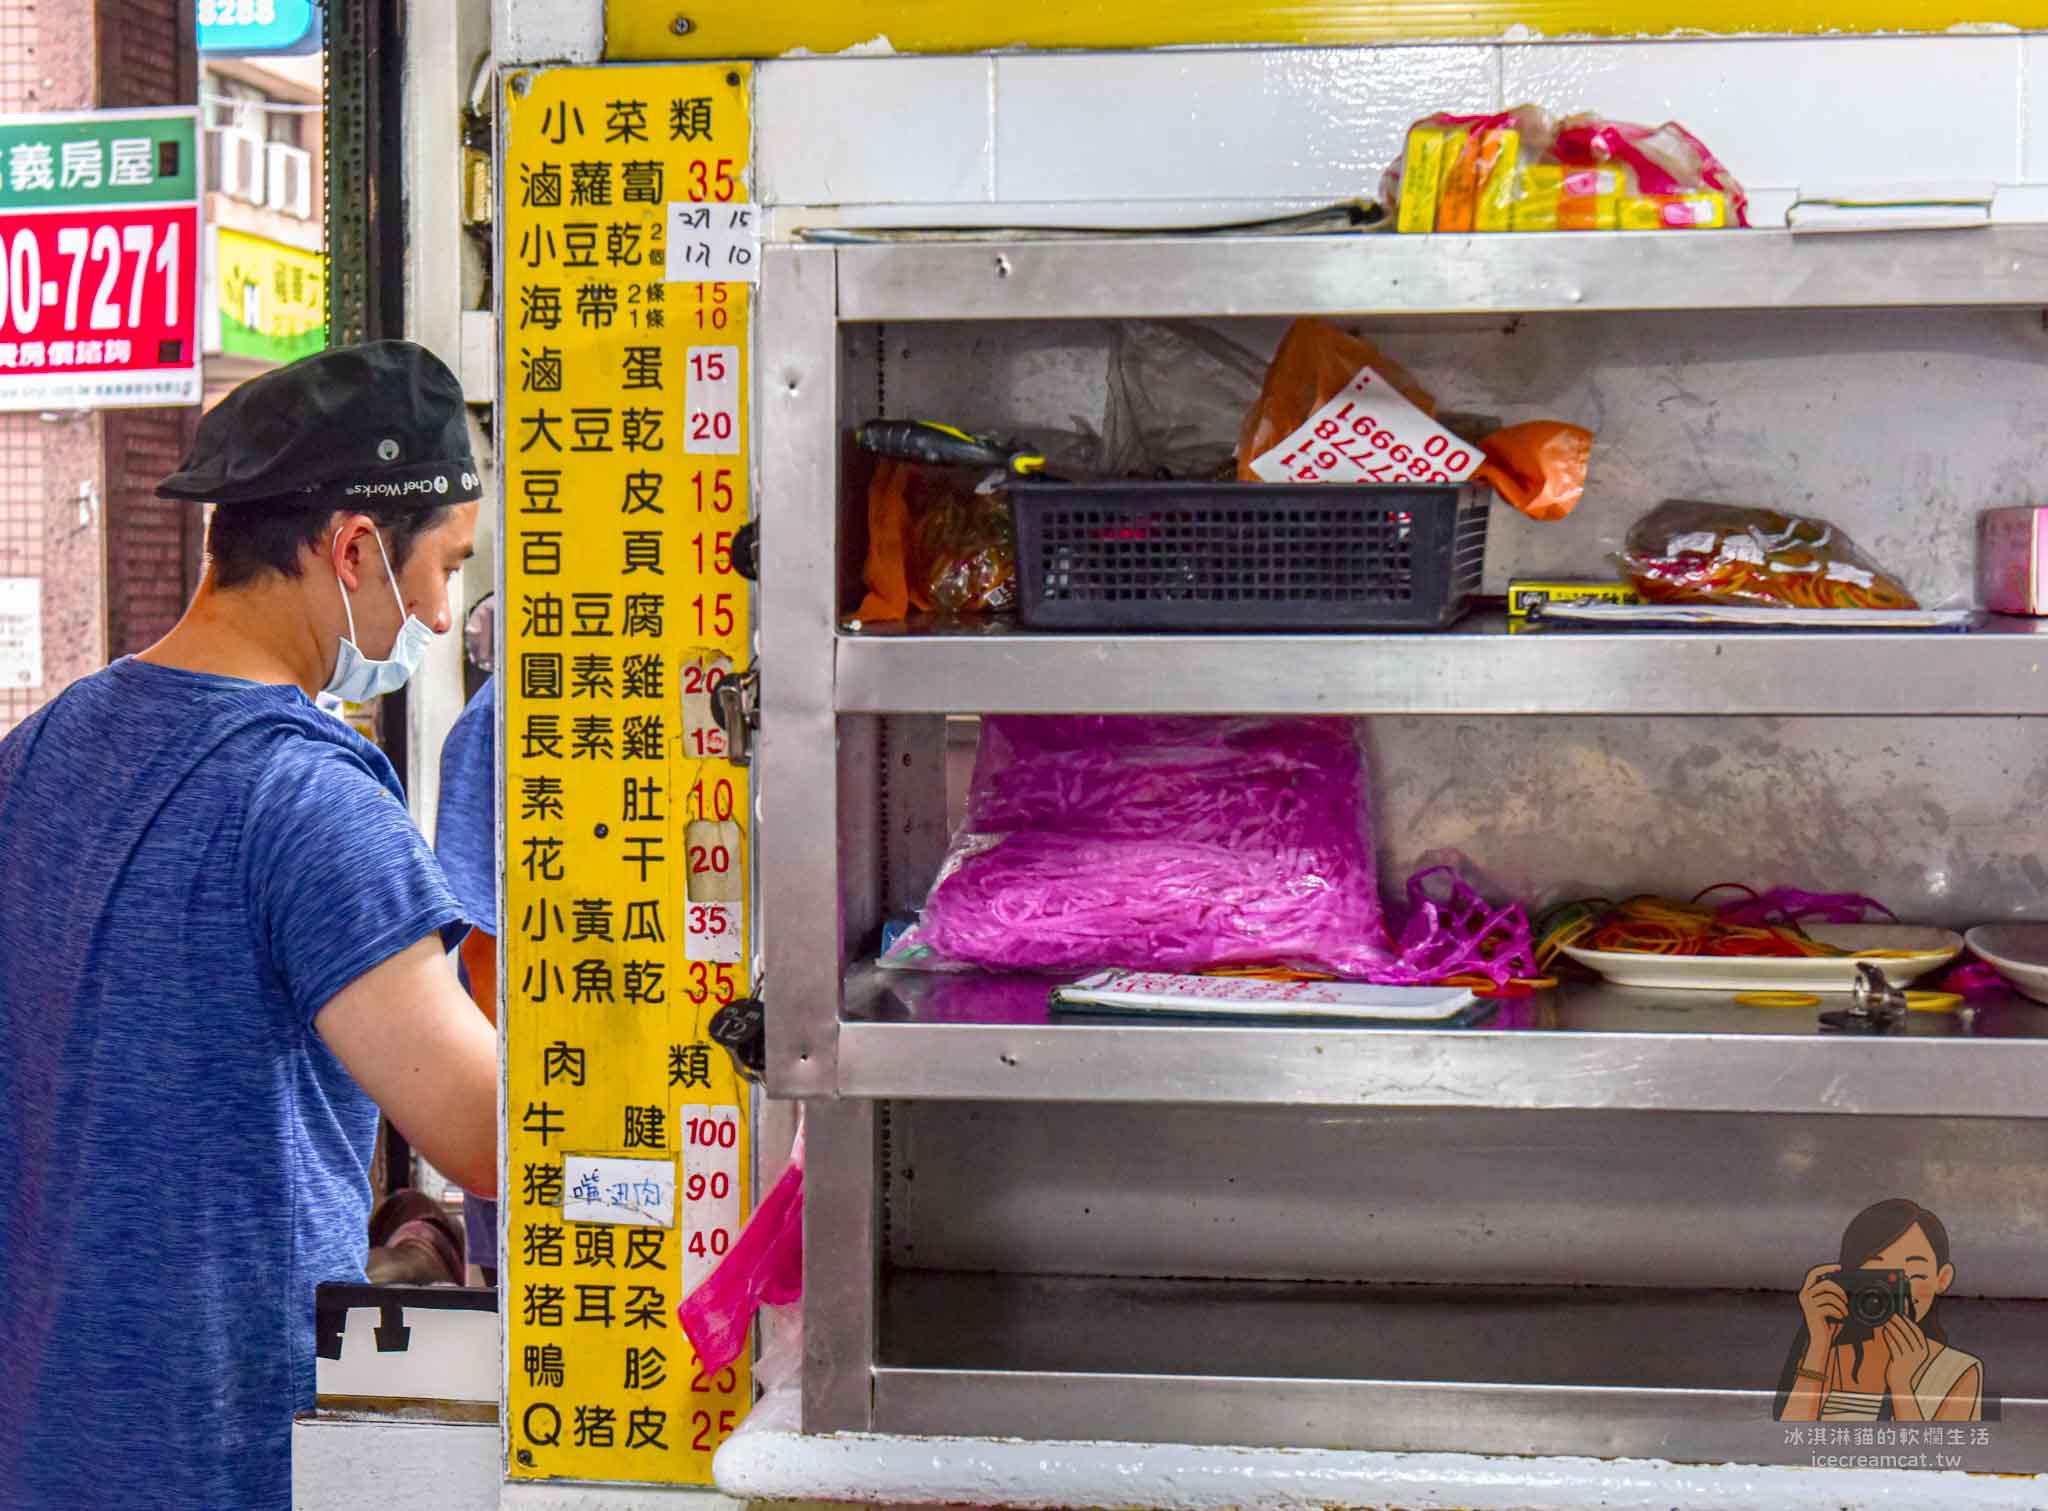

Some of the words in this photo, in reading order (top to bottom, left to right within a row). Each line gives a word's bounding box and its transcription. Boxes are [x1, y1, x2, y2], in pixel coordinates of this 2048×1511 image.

[541, 97, 713, 144] 小菜類
[0, 138, 153, 190] 義房屋
[520, 160, 664, 208] 滷蘿蔔
[688, 159, 734, 202] 35
[729, 210, 752, 229] 15
[520, 221, 642, 268] 小豆乾
[728, 244, 752, 265] 10
[520, 283, 618, 330] 海帶
[695, 282, 728, 303] 15
[695, 308, 728, 329] 10
[521, 346, 664, 392] 滷蛋
[690, 353, 726, 381] 15
[520, 408, 664, 453] 大豆乾
[691, 412, 732, 440] 20
[353, 484, 401, 498] Works
[404, 479, 433, 495] Chef
[520, 469, 664, 515] 豆皮
[691, 469, 733, 513] 15
[520, 530, 664, 576] 百頁
[692, 531, 734, 575] 15
[521, 592, 664, 638] 油豆腐
[692, 593, 734, 637] 15
[521, 653, 664, 699] 圓素雞
[521, 714, 664, 760] 長素雞
[522, 776, 664, 822] 素肚
[693, 778, 733, 822] 10
[522, 836, 665, 882] 花干
[689, 846, 729, 874] 20
[521, 897, 665, 943] 小黃瓜
[688, 905, 727, 935] 35
[522, 959, 665, 1004] 小魚乾
[688, 961, 734, 1004] 35
[544, 1041, 712, 1088] 肉類
[523, 1101, 666, 1149] 牛腱
[686, 1118, 736, 1148] 100
[686, 1172, 729, 1201] 90
[523, 1223, 667, 1270] 猪頭皮
[688, 1228, 729, 1258] 40
[523, 1283, 667, 1330] 猪耳朵
[523, 1402, 669, 1450] Q猪皮
